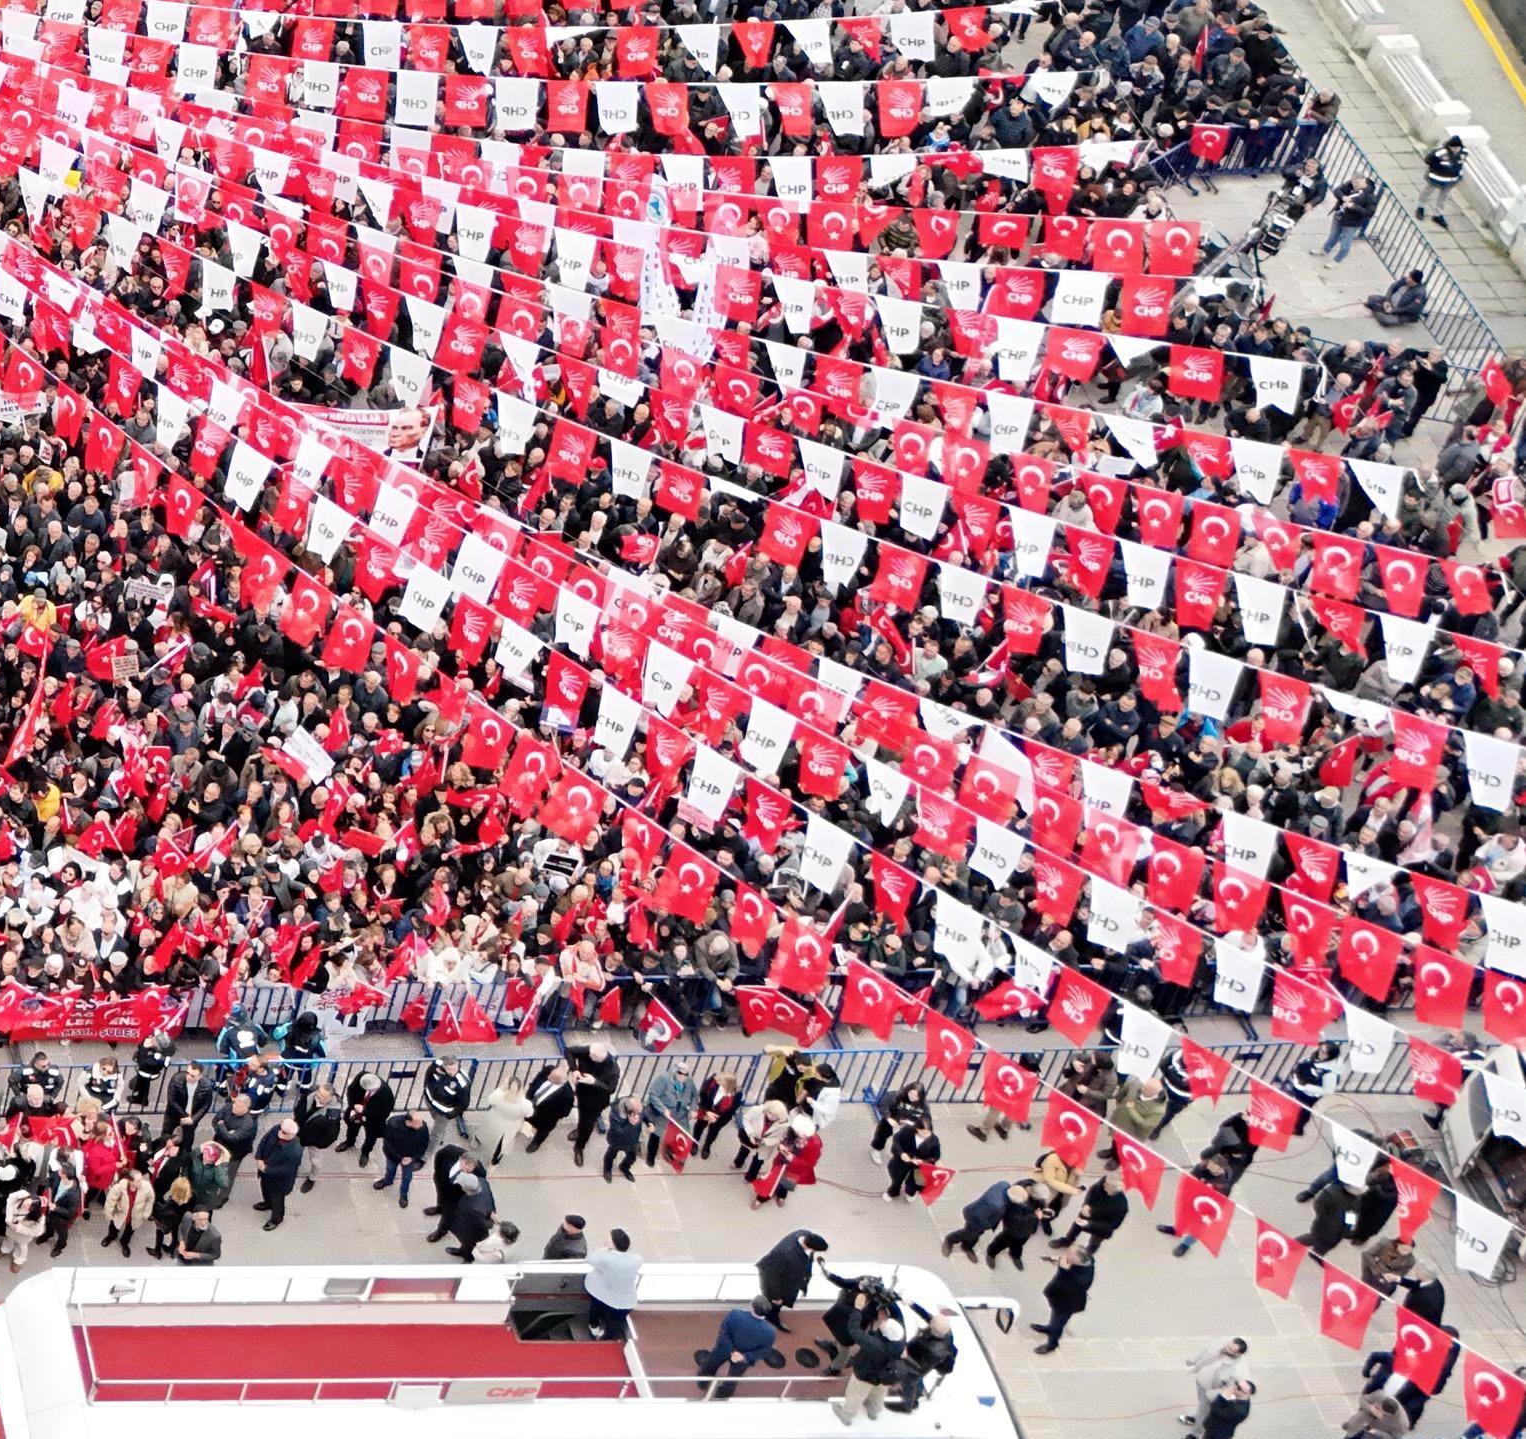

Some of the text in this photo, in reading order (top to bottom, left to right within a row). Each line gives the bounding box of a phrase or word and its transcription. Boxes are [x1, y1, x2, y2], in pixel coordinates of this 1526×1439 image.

[154, 22, 178, 32] CHP
[301, 42, 323, 53] CHP
[899, 37, 926, 47] CHP
[371, 46, 392, 56] CHP
[627, 50, 649, 61] CHP
[183, 68, 207, 78] CHP
[779, 185, 806, 195] CHP
[824, 183, 849, 194] CHP
[1008, 293, 1032, 305] CHP
[1062, 295, 1094, 306] CHP
[1135, 306, 1163, 317] CHP
[450, 341, 475, 355] CHP
[1183, 370, 1213, 383] CHP
[1259, 380, 1289, 391] CHP
[827, 385, 852, 398] CHP
[994, 424, 1018, 435] CHP
[195, 441, 217, 458] CHP
[756, 444, 782, 460] CHP
[904, 501, 933, 518] CHP
[365, 561, 385, 580] CHP
[462, 566, 485, 584] CHP
[412, 590, 435, 610] CHP
[1247, 610, 1270, 624] CHP
[658, 625, 685, 644] CHP
[945, 927, 967, 942] CHP
[486, 1387, 537, 1397] CHP
